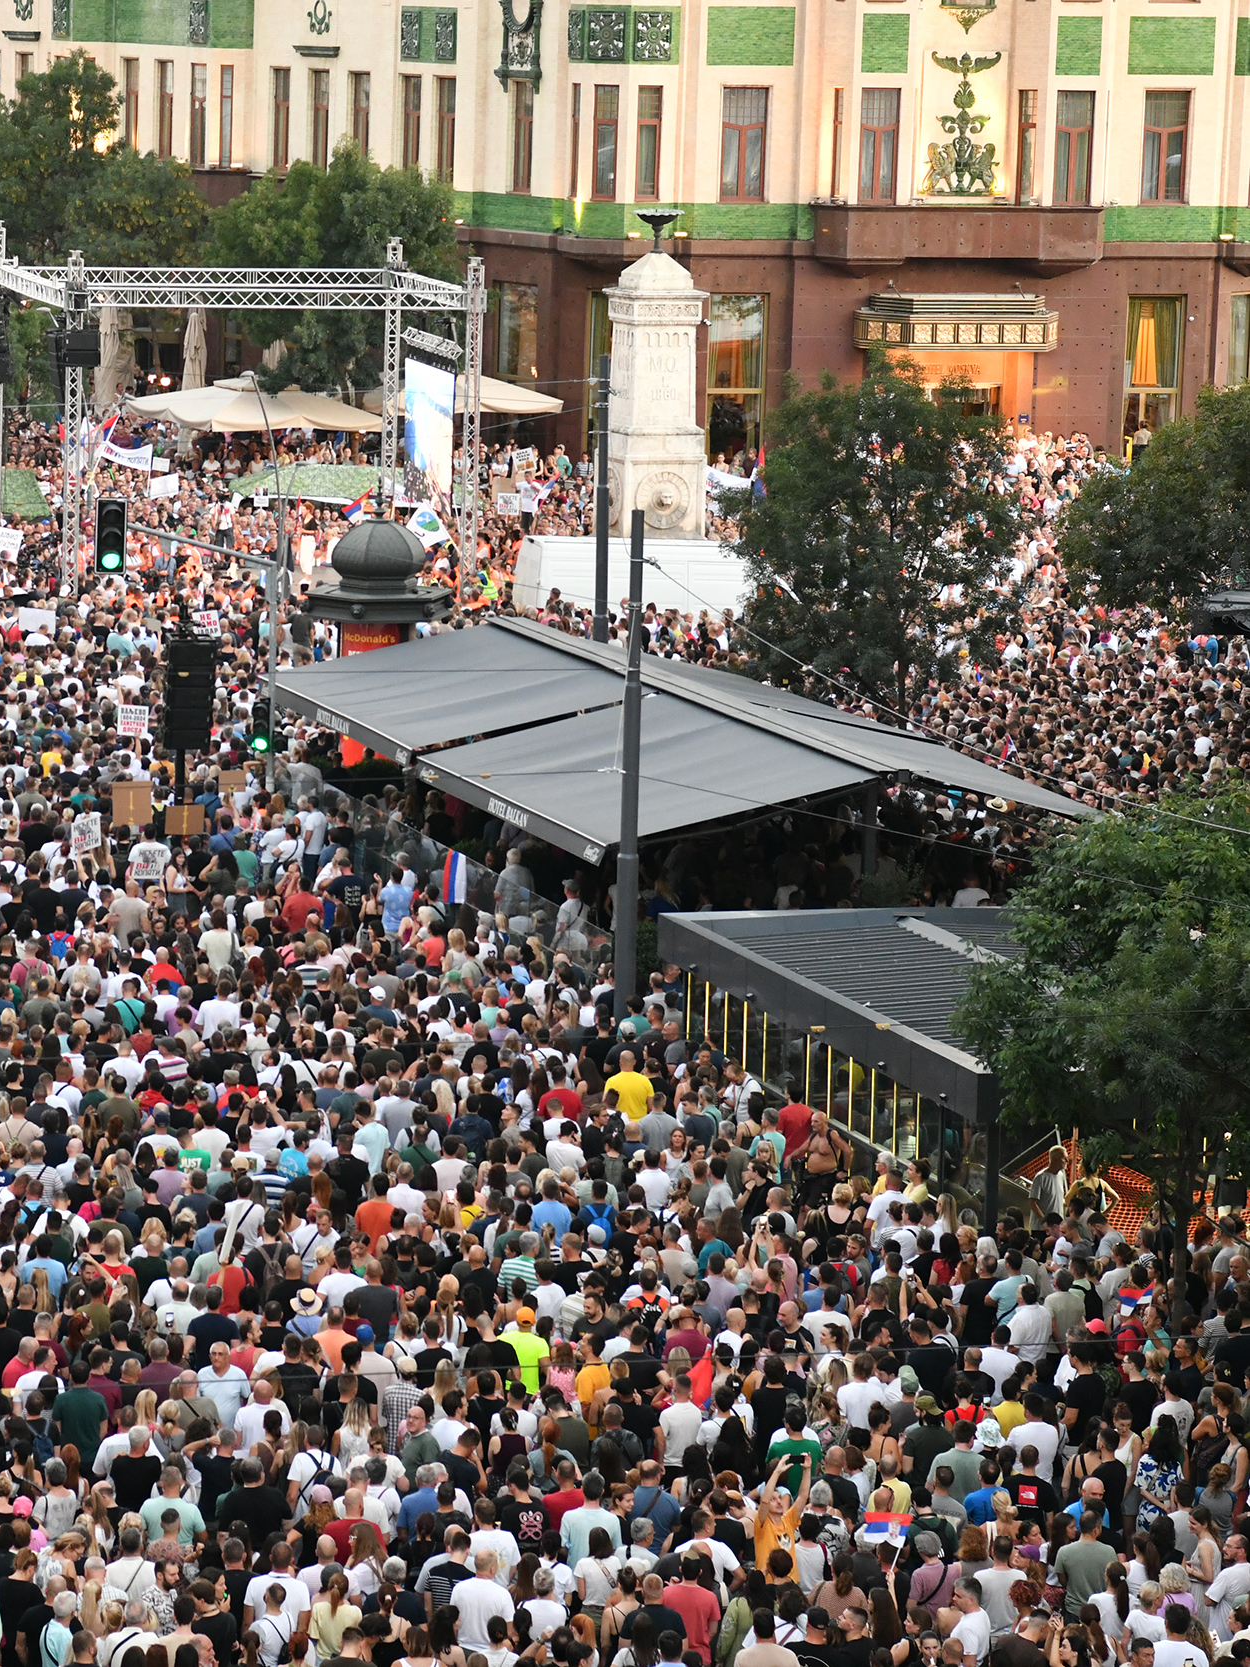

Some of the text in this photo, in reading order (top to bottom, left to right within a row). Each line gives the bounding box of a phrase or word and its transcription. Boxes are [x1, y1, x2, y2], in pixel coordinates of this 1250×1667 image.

[200, 613, 212, 621] НЕ
[344, 633, 396, 644] McDonald's
[316, 708, 350, 734] HOTEL BALKAN
[487, 797, 529, 827] HOTEL BALKAN
[179, 1157, 202, 1169] JUST
